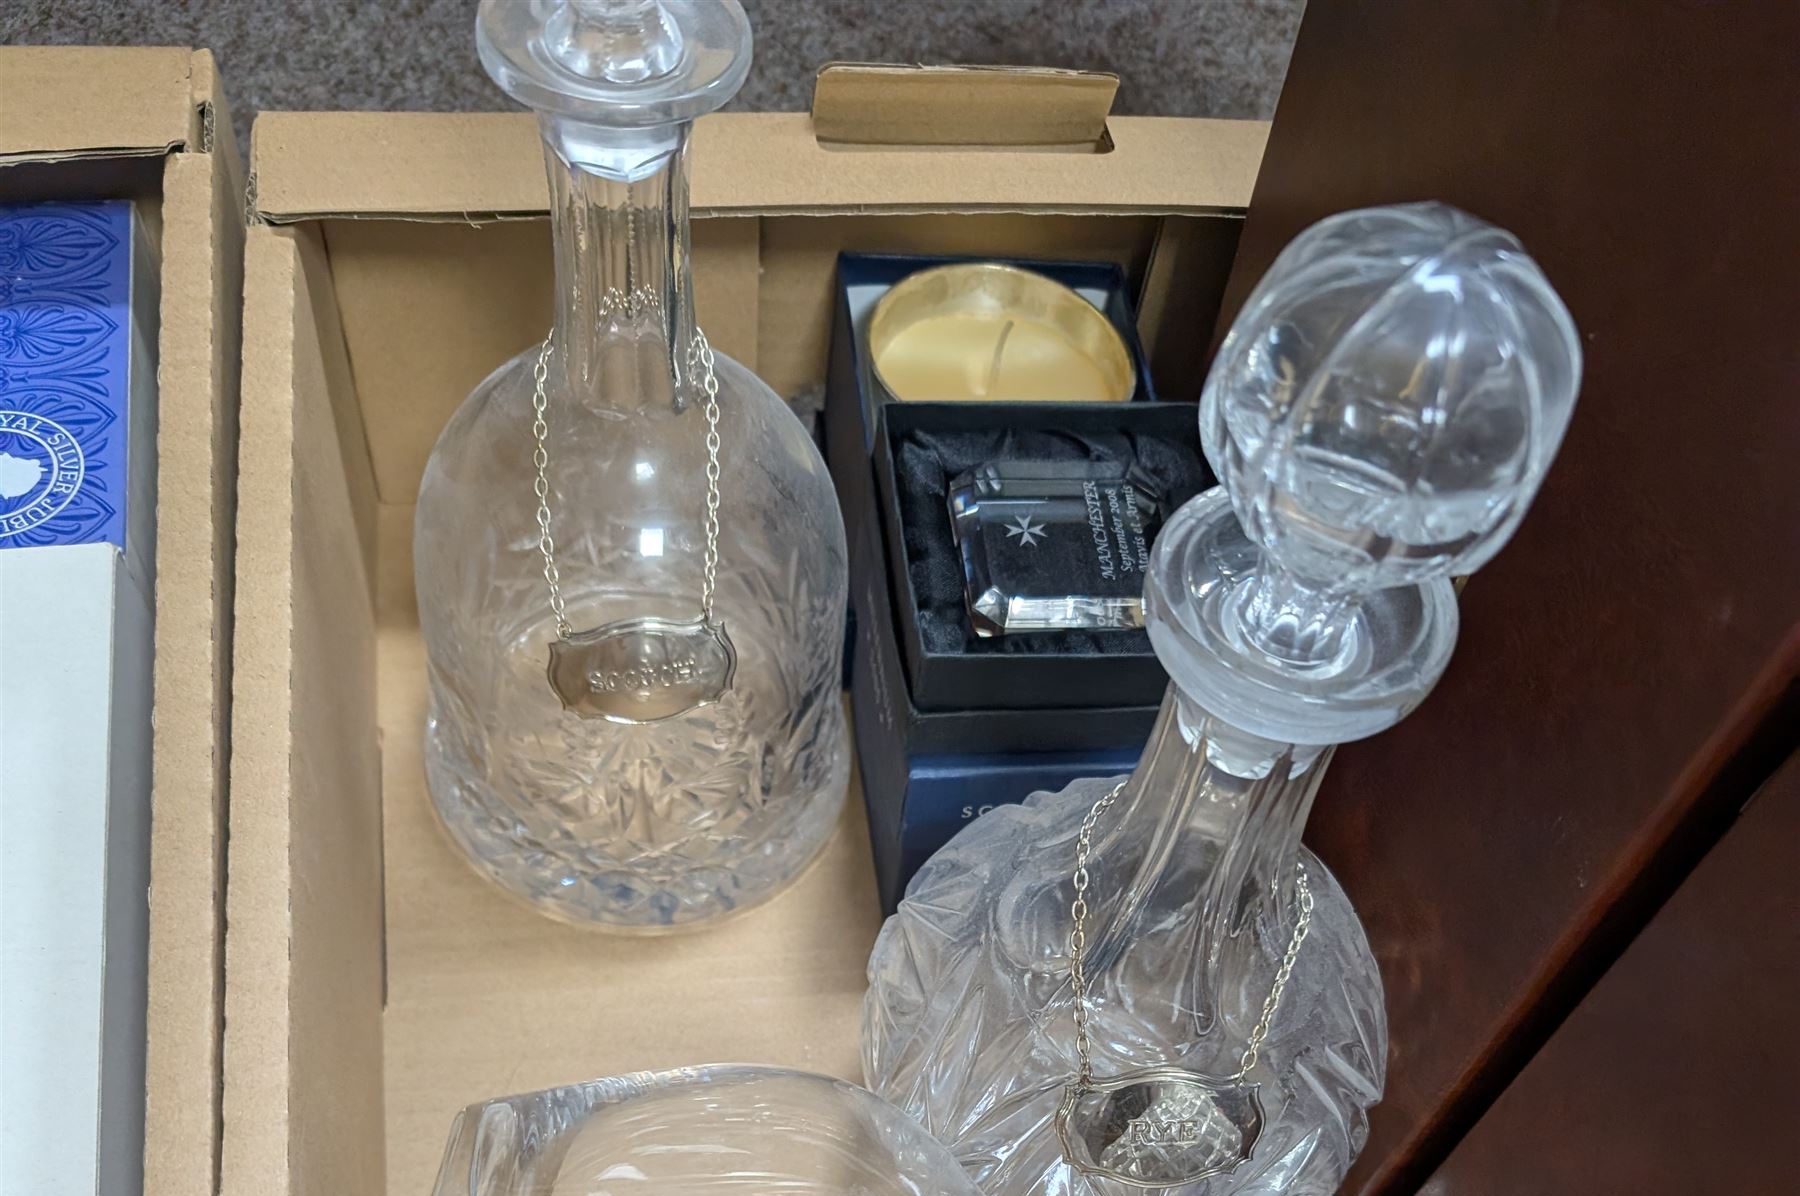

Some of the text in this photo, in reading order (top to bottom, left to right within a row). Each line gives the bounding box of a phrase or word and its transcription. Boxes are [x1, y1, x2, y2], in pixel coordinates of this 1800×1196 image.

[47, 433, 79, 494] SILVER
[1122, 484, 1140, 521] Armis
[1083, 481, 1116, 580] MANCHESTER
[1105, 488, 1136, 573] September 2008
[1130, 523, 1144, 534] et
[1126, 1119, 1200, 1146] RYE
